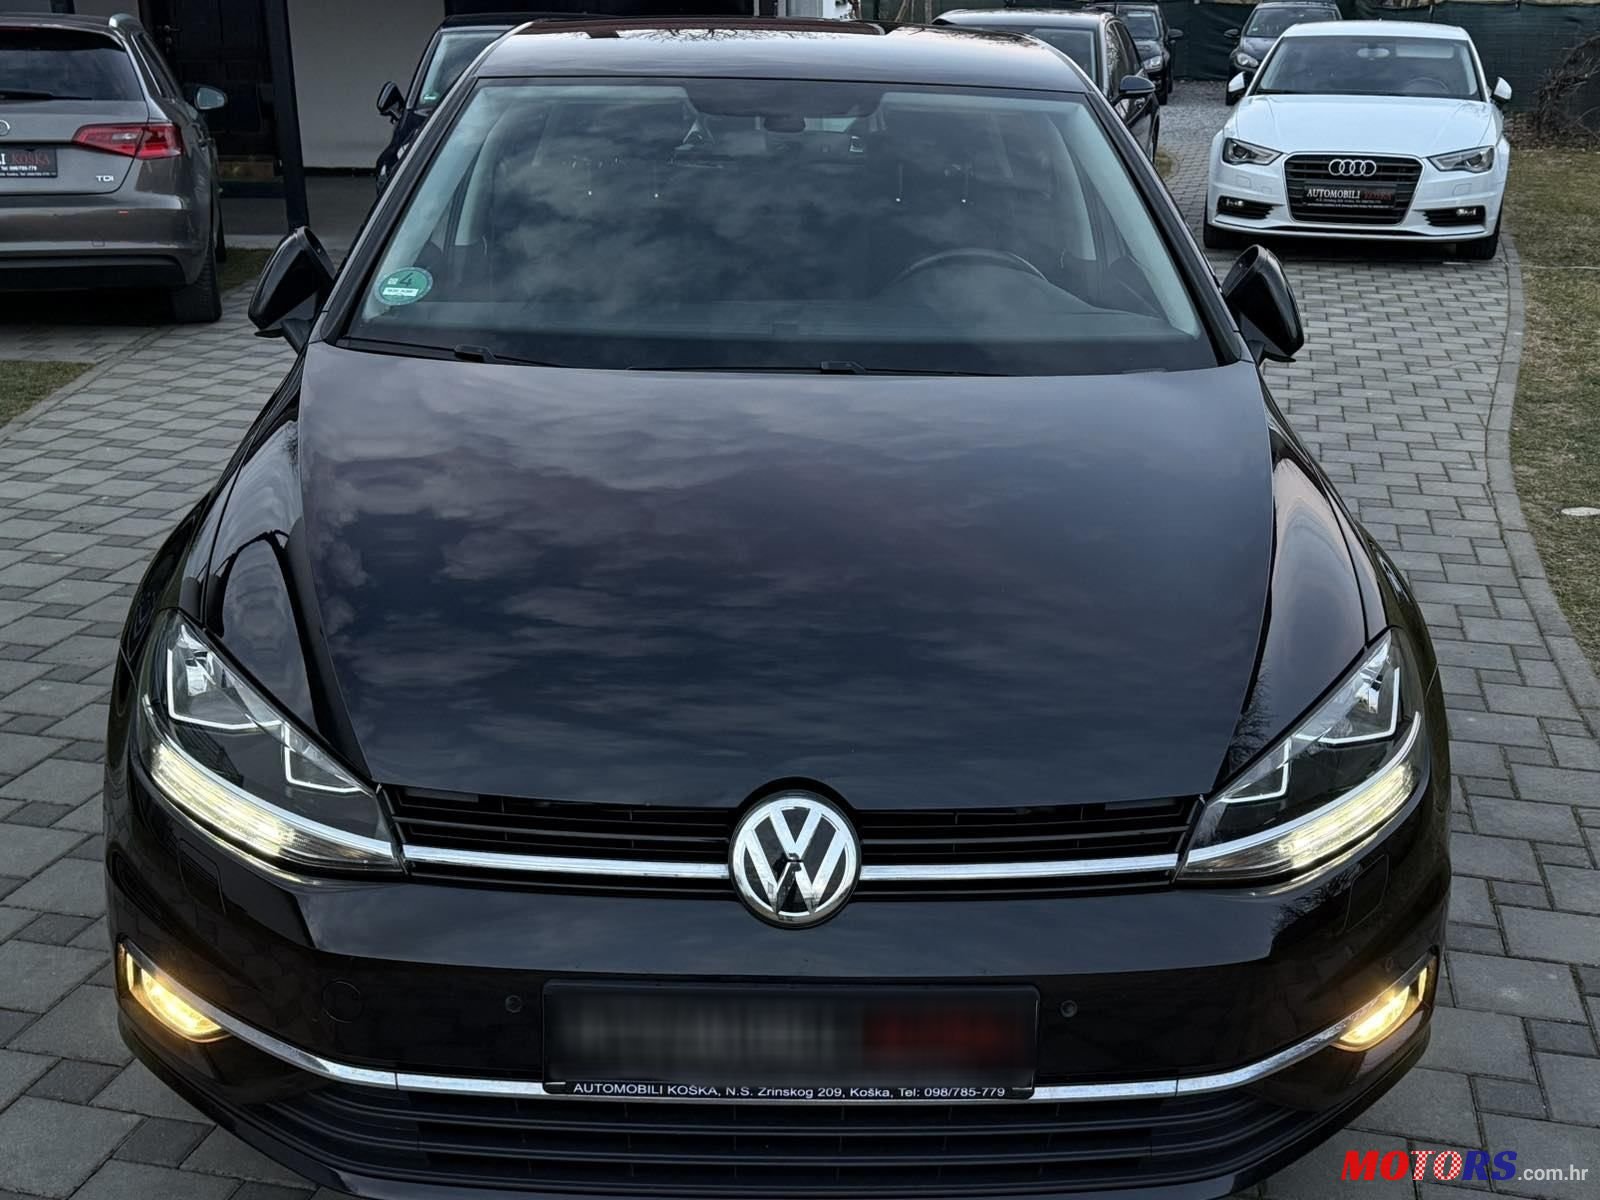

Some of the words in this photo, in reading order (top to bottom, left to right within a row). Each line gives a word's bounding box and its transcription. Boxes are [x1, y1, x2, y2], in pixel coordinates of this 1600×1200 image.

[1306, 188, 1361, 199] AUTOMOBILI
[399, 272, 414, 287] 4
[573, 1083, 663, 1095] AUTOMOBILI
[667, 1084, 722, 1098] KOŠKA,
[725, 1086, 753, 1097] N.S.
[757, 1087, 814, 1099] Zrinskog
[817, 1087, 846, 1099] 209,
[850, 1087, 894, 1099] Koška,
[899, 1087, 920, 1097] Tel:
[923, 1087, 1006, 1097] 098/785-779
